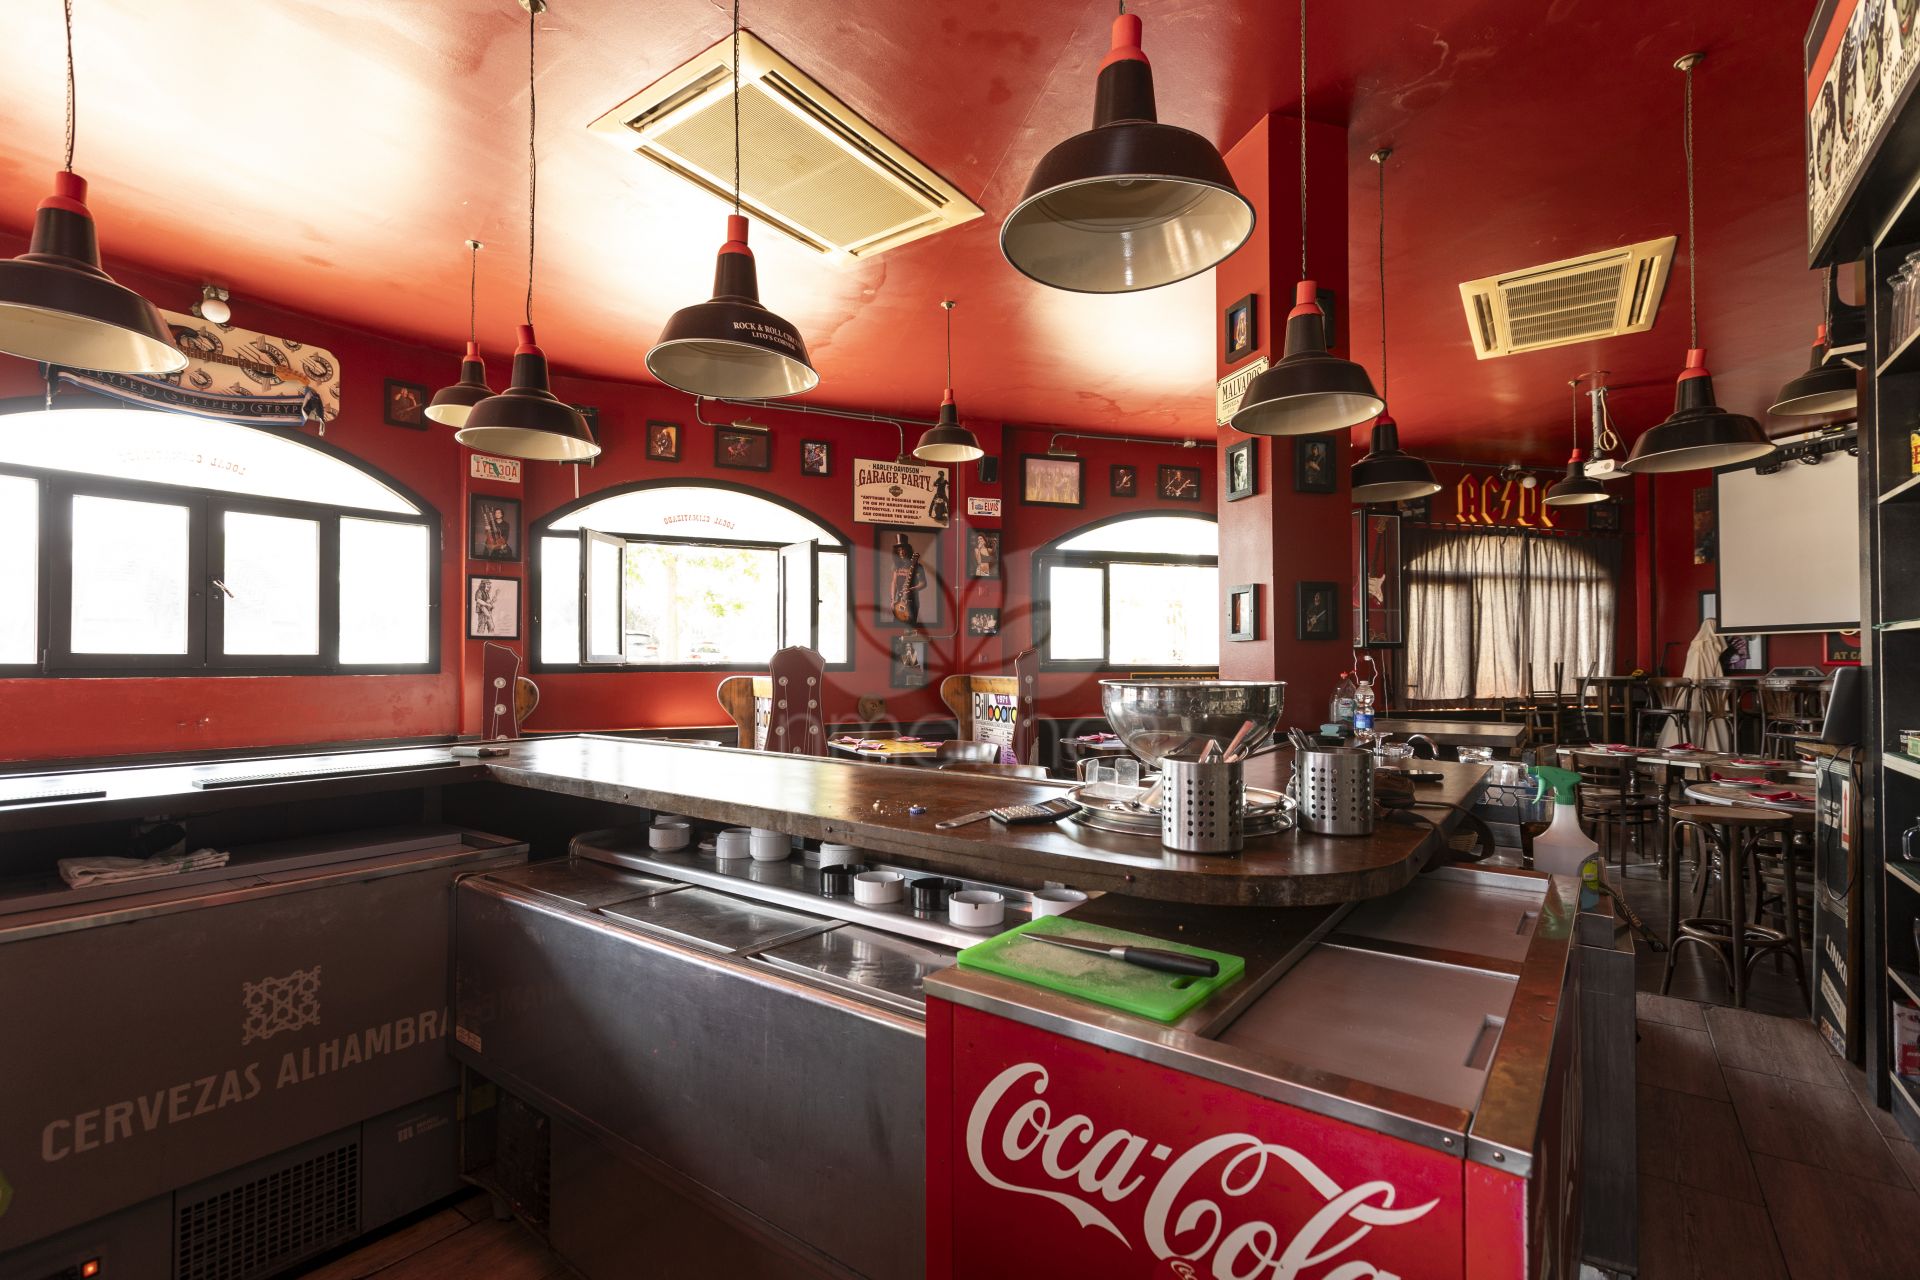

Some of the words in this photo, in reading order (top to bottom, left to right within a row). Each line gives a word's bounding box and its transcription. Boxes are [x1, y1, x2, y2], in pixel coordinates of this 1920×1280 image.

[733, 322, 756, 330] ROCK
[764, 325, 783, 337] ROLL
[872, 463, 919, 474] HARLEY-DAVIDSON
[857, 468, 898, 487] GARAGE
[901, 472, 934, 492] PARTY
[984, 502, 999, 511] ELVIS
[997, 694, 1009, 704] 1971
[41, 1062, 263, 1163] CERVEZAS
